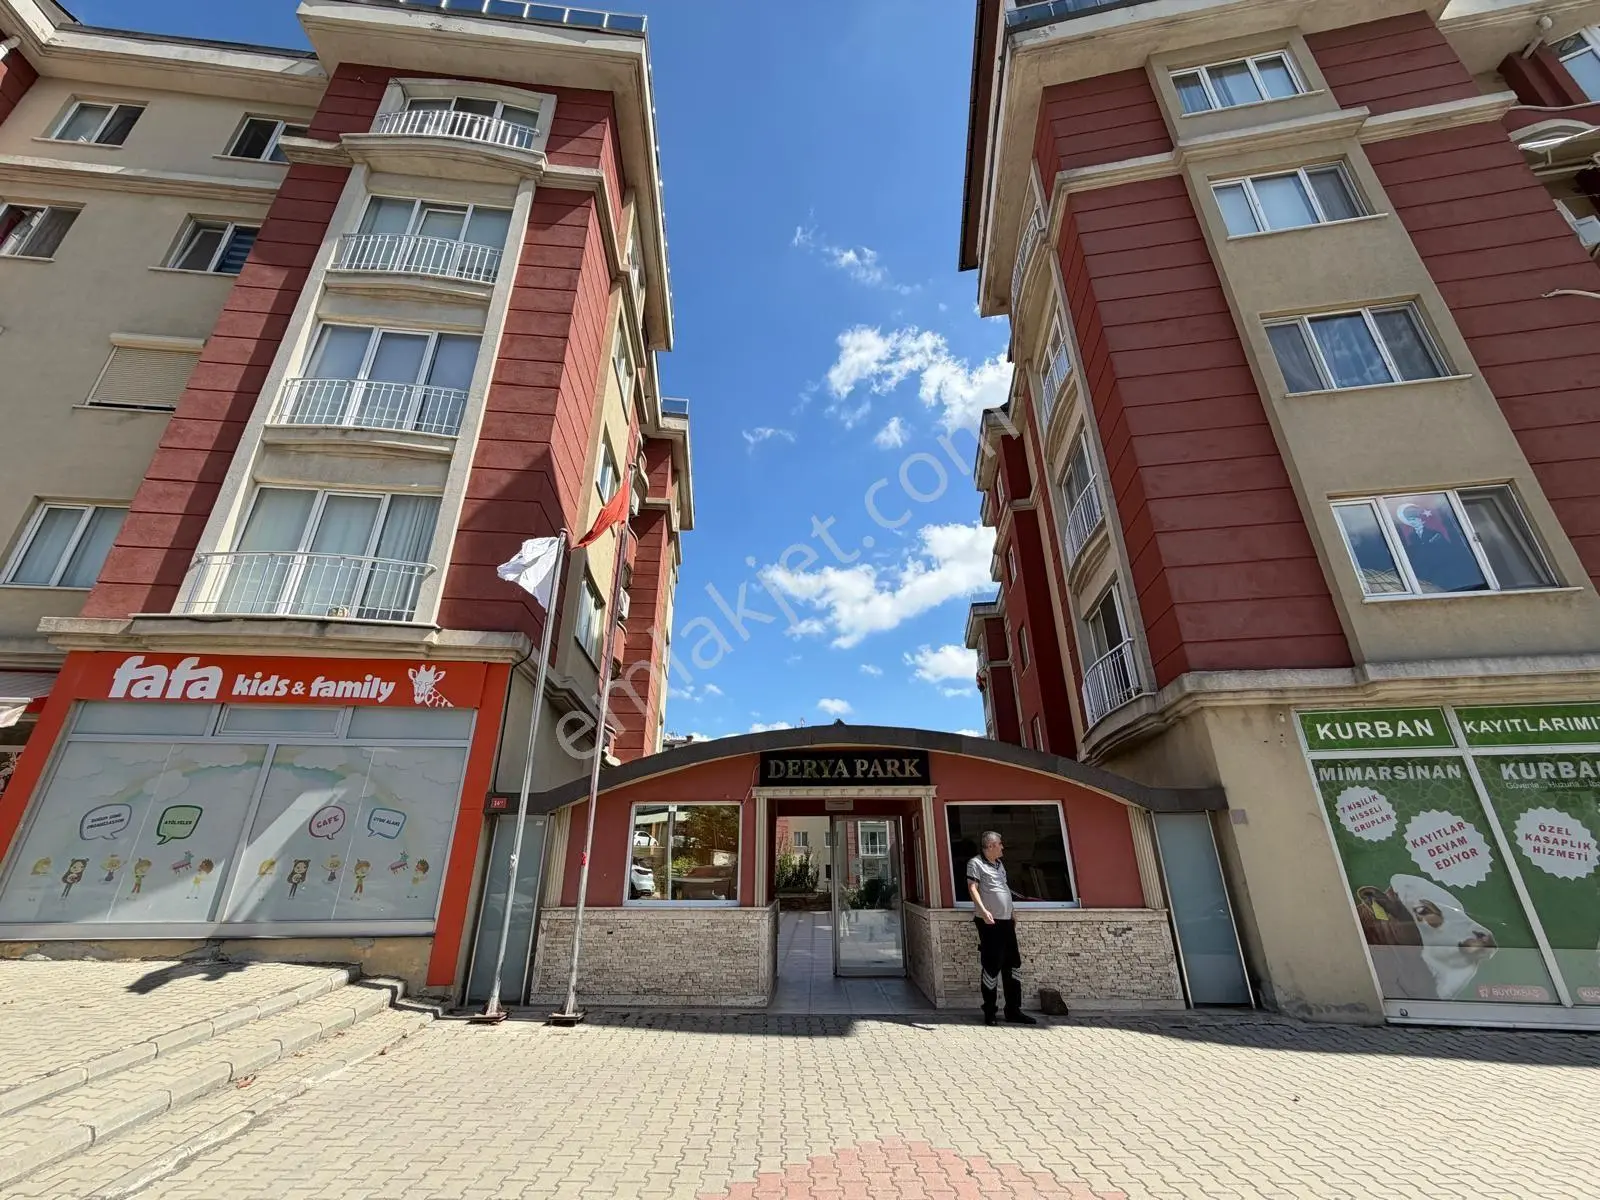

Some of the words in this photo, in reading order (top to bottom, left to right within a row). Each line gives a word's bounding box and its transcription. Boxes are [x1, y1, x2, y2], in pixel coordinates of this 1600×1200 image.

[108, 655, 223, 699] fafa
[232, 672, 288, 697] kids
[291, 682, 305, 695] &
[309, 674, 396, 703] family
[1315, 719, 1435, 740] KURBAN
[767, 759, 850, 779] DERYA
[854, 758, 922, 778] PARK
[1318, 762, 1462, 782] MİMARSİNAN
[1500, 760, 1600, 780] KURBA
[1340, 806, 1346, 814] 7
[1347, 793, 1379, 812] KİŞİLİK
[316, 815, 340, 829] CAFE
[1354, 813, 1393, 833] GRUPLAR
[1538, 822, 1572, 836] ÖZEL
[1410, 821, 1467, 849] KAYITLAR
[1525, 833, 1591, 851] KASAPLIK
[1427, 835, 1468, 858] DEVAM
[1532, 845, 1588, 862] HİZMETİ
